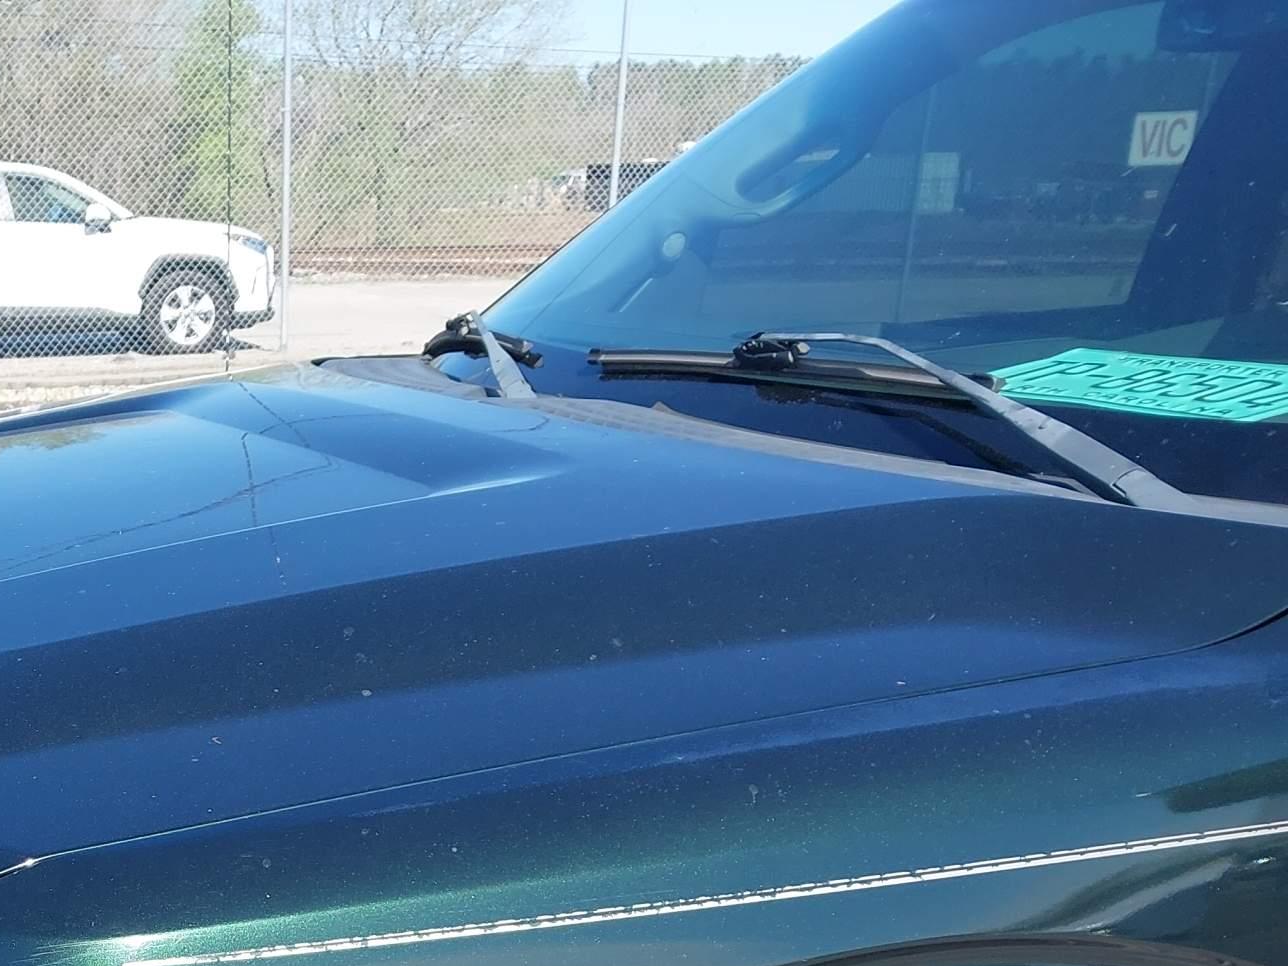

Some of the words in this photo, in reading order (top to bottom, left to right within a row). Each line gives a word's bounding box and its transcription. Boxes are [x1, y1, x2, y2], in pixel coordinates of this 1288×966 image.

[1140, 117, 1188, 159] VIC
[1003, 360, 1288, 409] TP-86504
[1118, 356, 1288, 378] TRANSPORTER
[1009, 384, 1068, 394] RTH
[1082, 391, 1234, 416] CAROLINA
